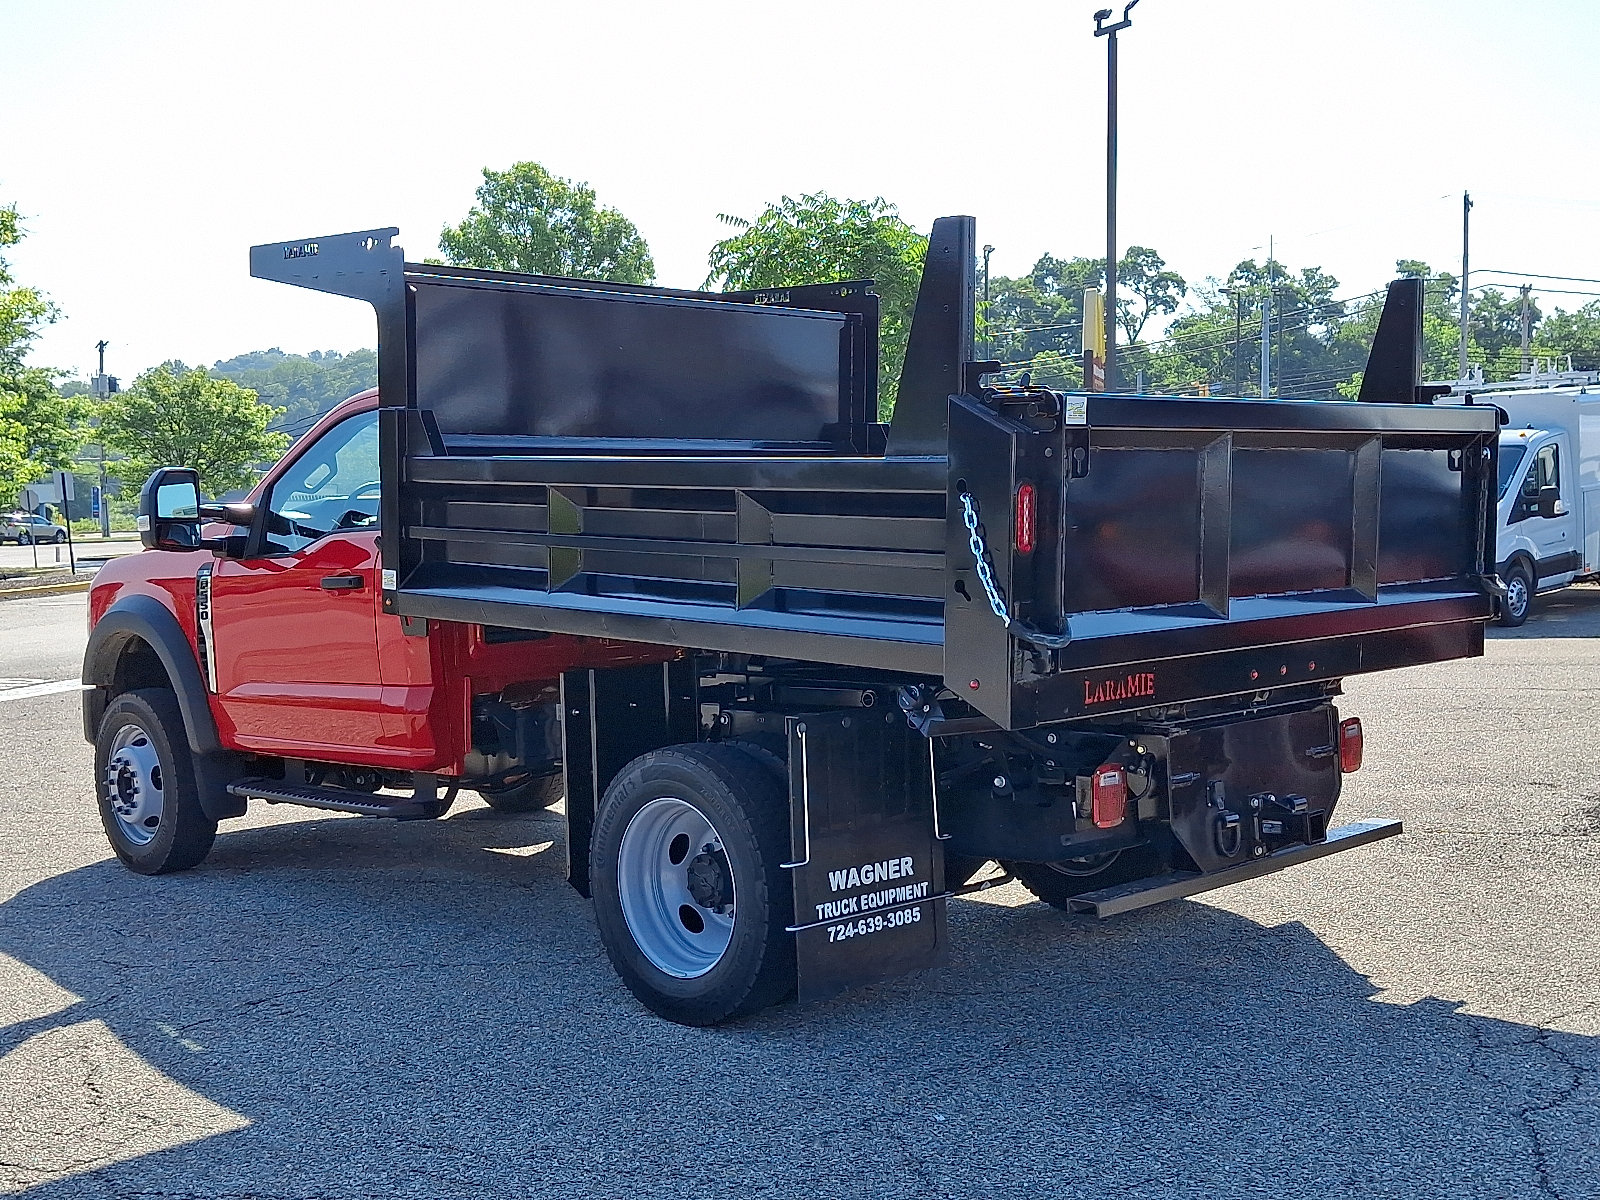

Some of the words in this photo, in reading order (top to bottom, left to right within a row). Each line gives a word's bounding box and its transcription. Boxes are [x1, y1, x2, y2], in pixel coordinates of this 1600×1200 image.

[1084, 673, 1155, 706] LARAMIE
[828, 856, 914, 892] WAGNER
[815, 896, 859, 920] TRUCK
[861, 881, 929, 911] EQUIPMENT
[827, 906, 921, 943] 724-639-3085
